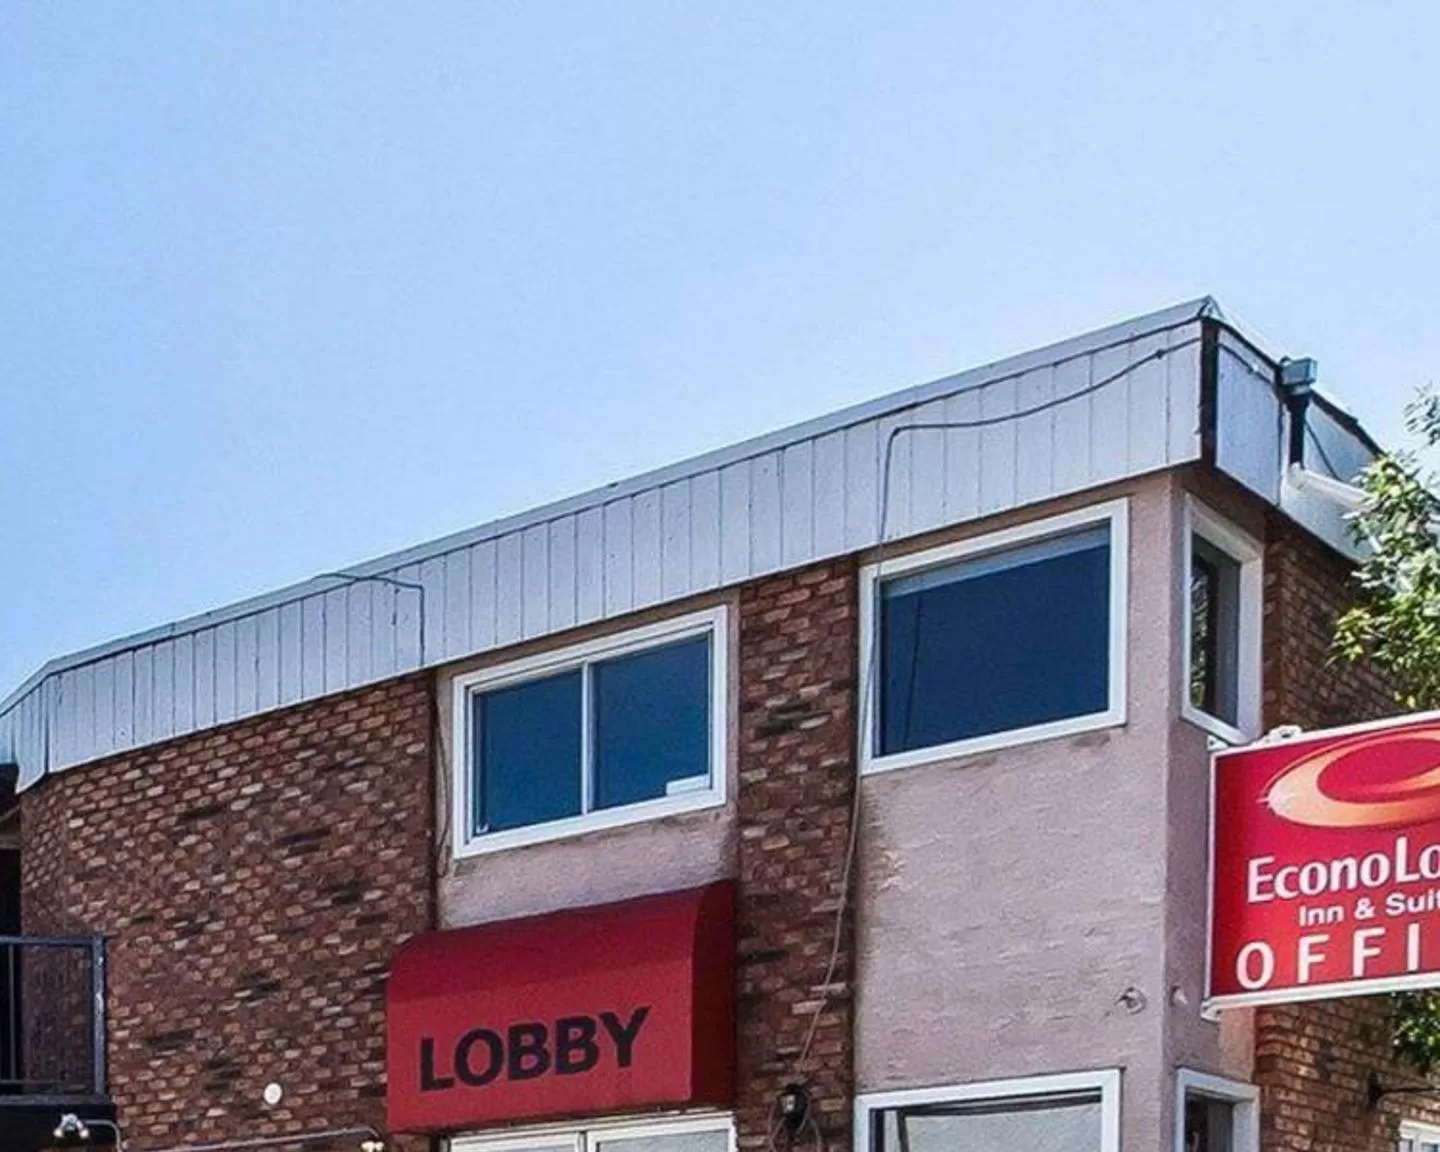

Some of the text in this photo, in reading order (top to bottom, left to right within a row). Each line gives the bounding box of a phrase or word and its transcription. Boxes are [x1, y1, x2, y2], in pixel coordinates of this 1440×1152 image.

[1298, 905, 1344, 928] Inn
[1354, 897, 1376, 920] &
[1236, 922, 1421, 990] OFFI
[420, 1005, 652, 1092] LOBBY
